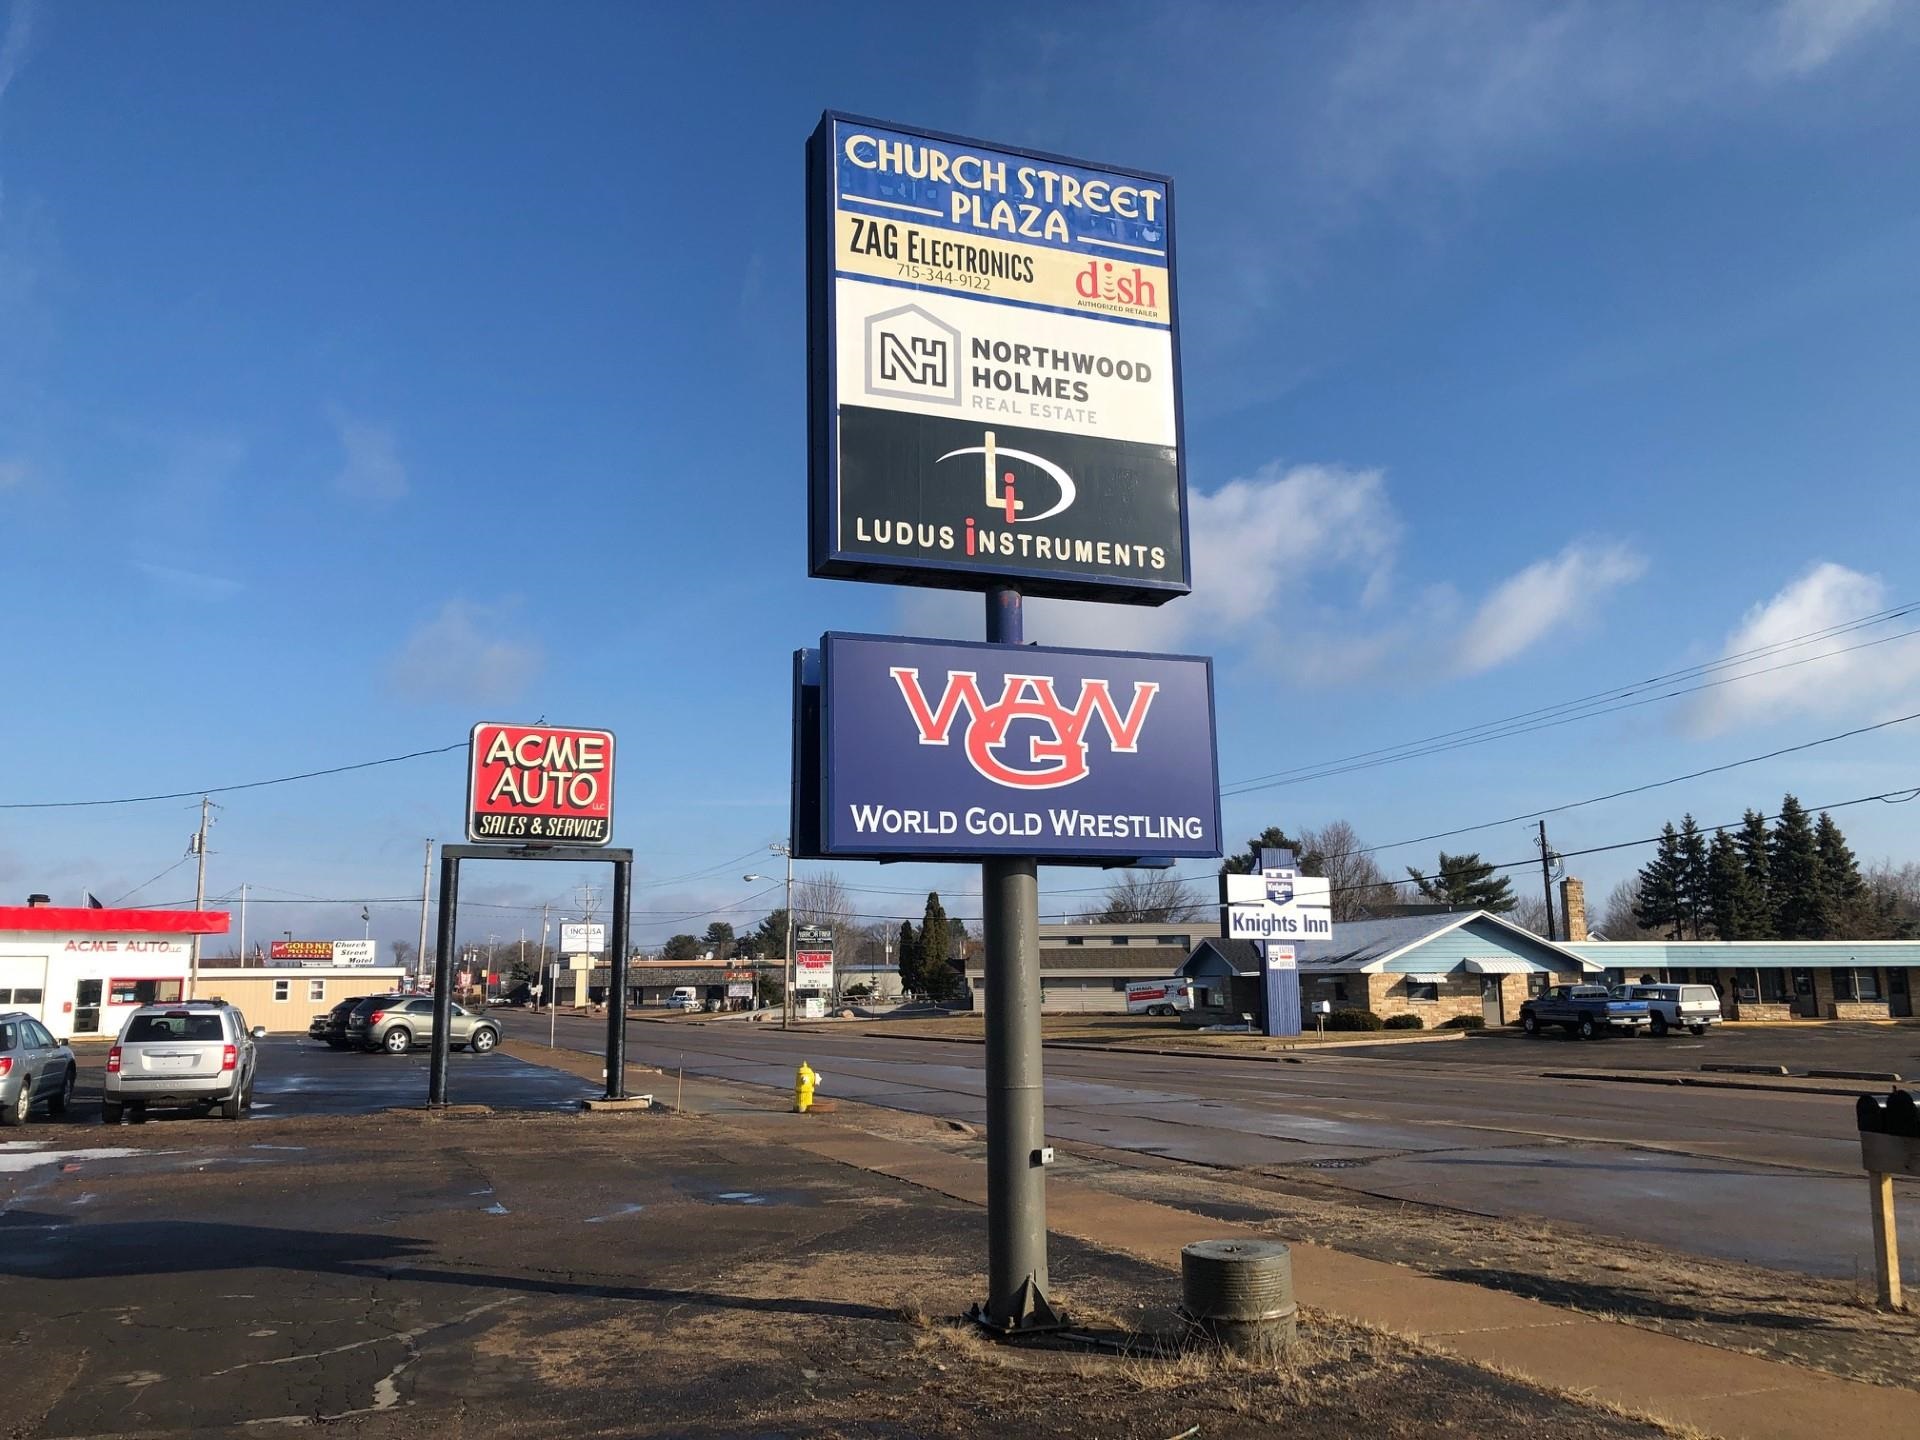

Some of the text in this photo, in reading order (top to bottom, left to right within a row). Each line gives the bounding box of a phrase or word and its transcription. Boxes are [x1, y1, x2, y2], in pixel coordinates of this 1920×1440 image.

[845, 134, 1162, 222] CHURCH STREET
[951, 190, 1070, 243] PLAZA
[850, 218, 1035, 284] ZAG ELECTRONICS
[897, 263, 991, 291] 715-344-9122
[1076, 260, 1156, 308] dish
[1077, 300, 1158, 318] AUTHORIZED RETAILER
[972, 337, 1152, 384] NORTHWOOD
[972, 366, 1089, 403] HOLMES
[972, 396, 1097, 425] REAL ESTATE
[857, 517, 955, 550] LUDUS
[485, 730, 605, 770] ACME
[489, 767, 598, 808] AUTO
[480, 815, 605, 838] SALES & SERVICE
[850, 804, 1203, 839] WORLD GOLD WRESTLING
[1233, 912, 1328, 936] Knights Inn
[64, 940, 118, 952] ACME
[125, 940, 169, 952] AUTO
